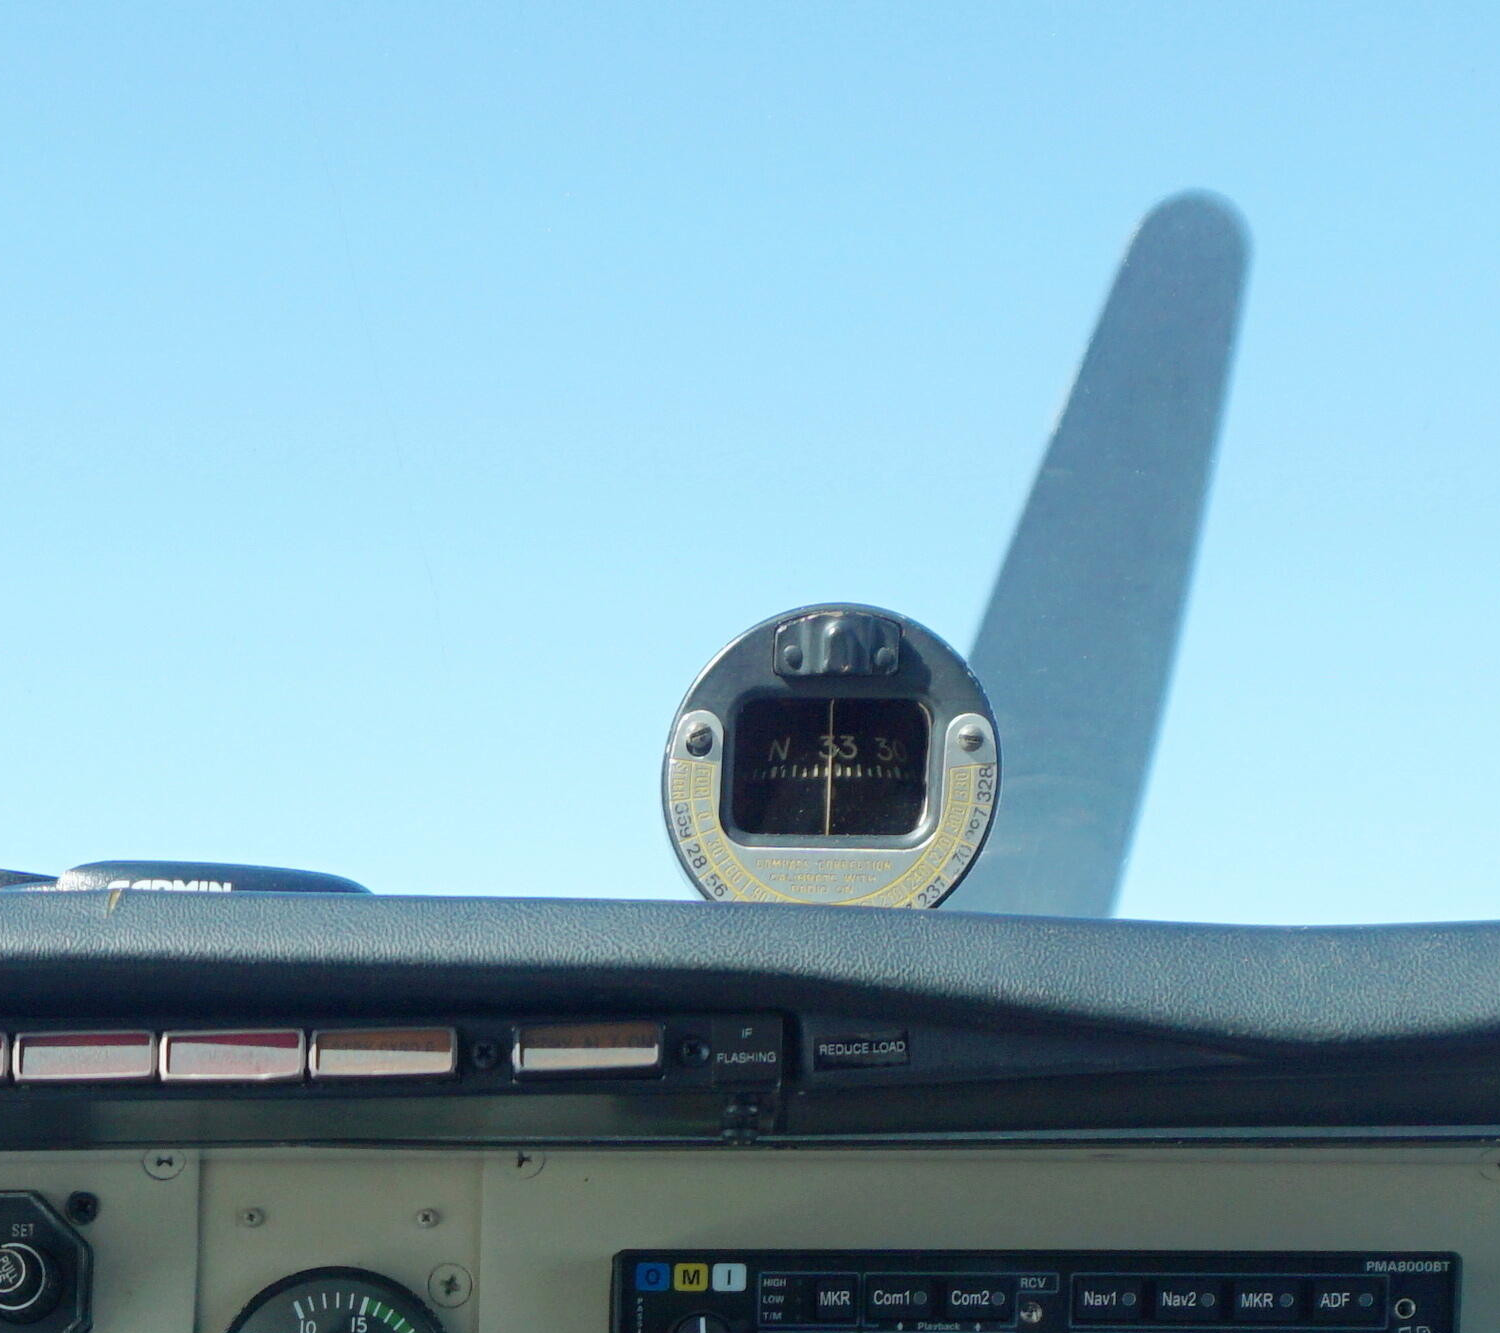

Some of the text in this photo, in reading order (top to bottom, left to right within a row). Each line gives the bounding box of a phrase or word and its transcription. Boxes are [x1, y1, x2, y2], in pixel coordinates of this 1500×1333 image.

[741, 1028, 753, 1039] IF
[717, 1040, 906, 1064] FLASHING REDUCE LOAD
[12, 1224, 34, 1237] SET
[874, 1290, 989, 1305] Com1 Com2
[1084, 1292, 1196, 1306] Nav1 Nav2
[1320, 1293, 1350, 1308] ADF
